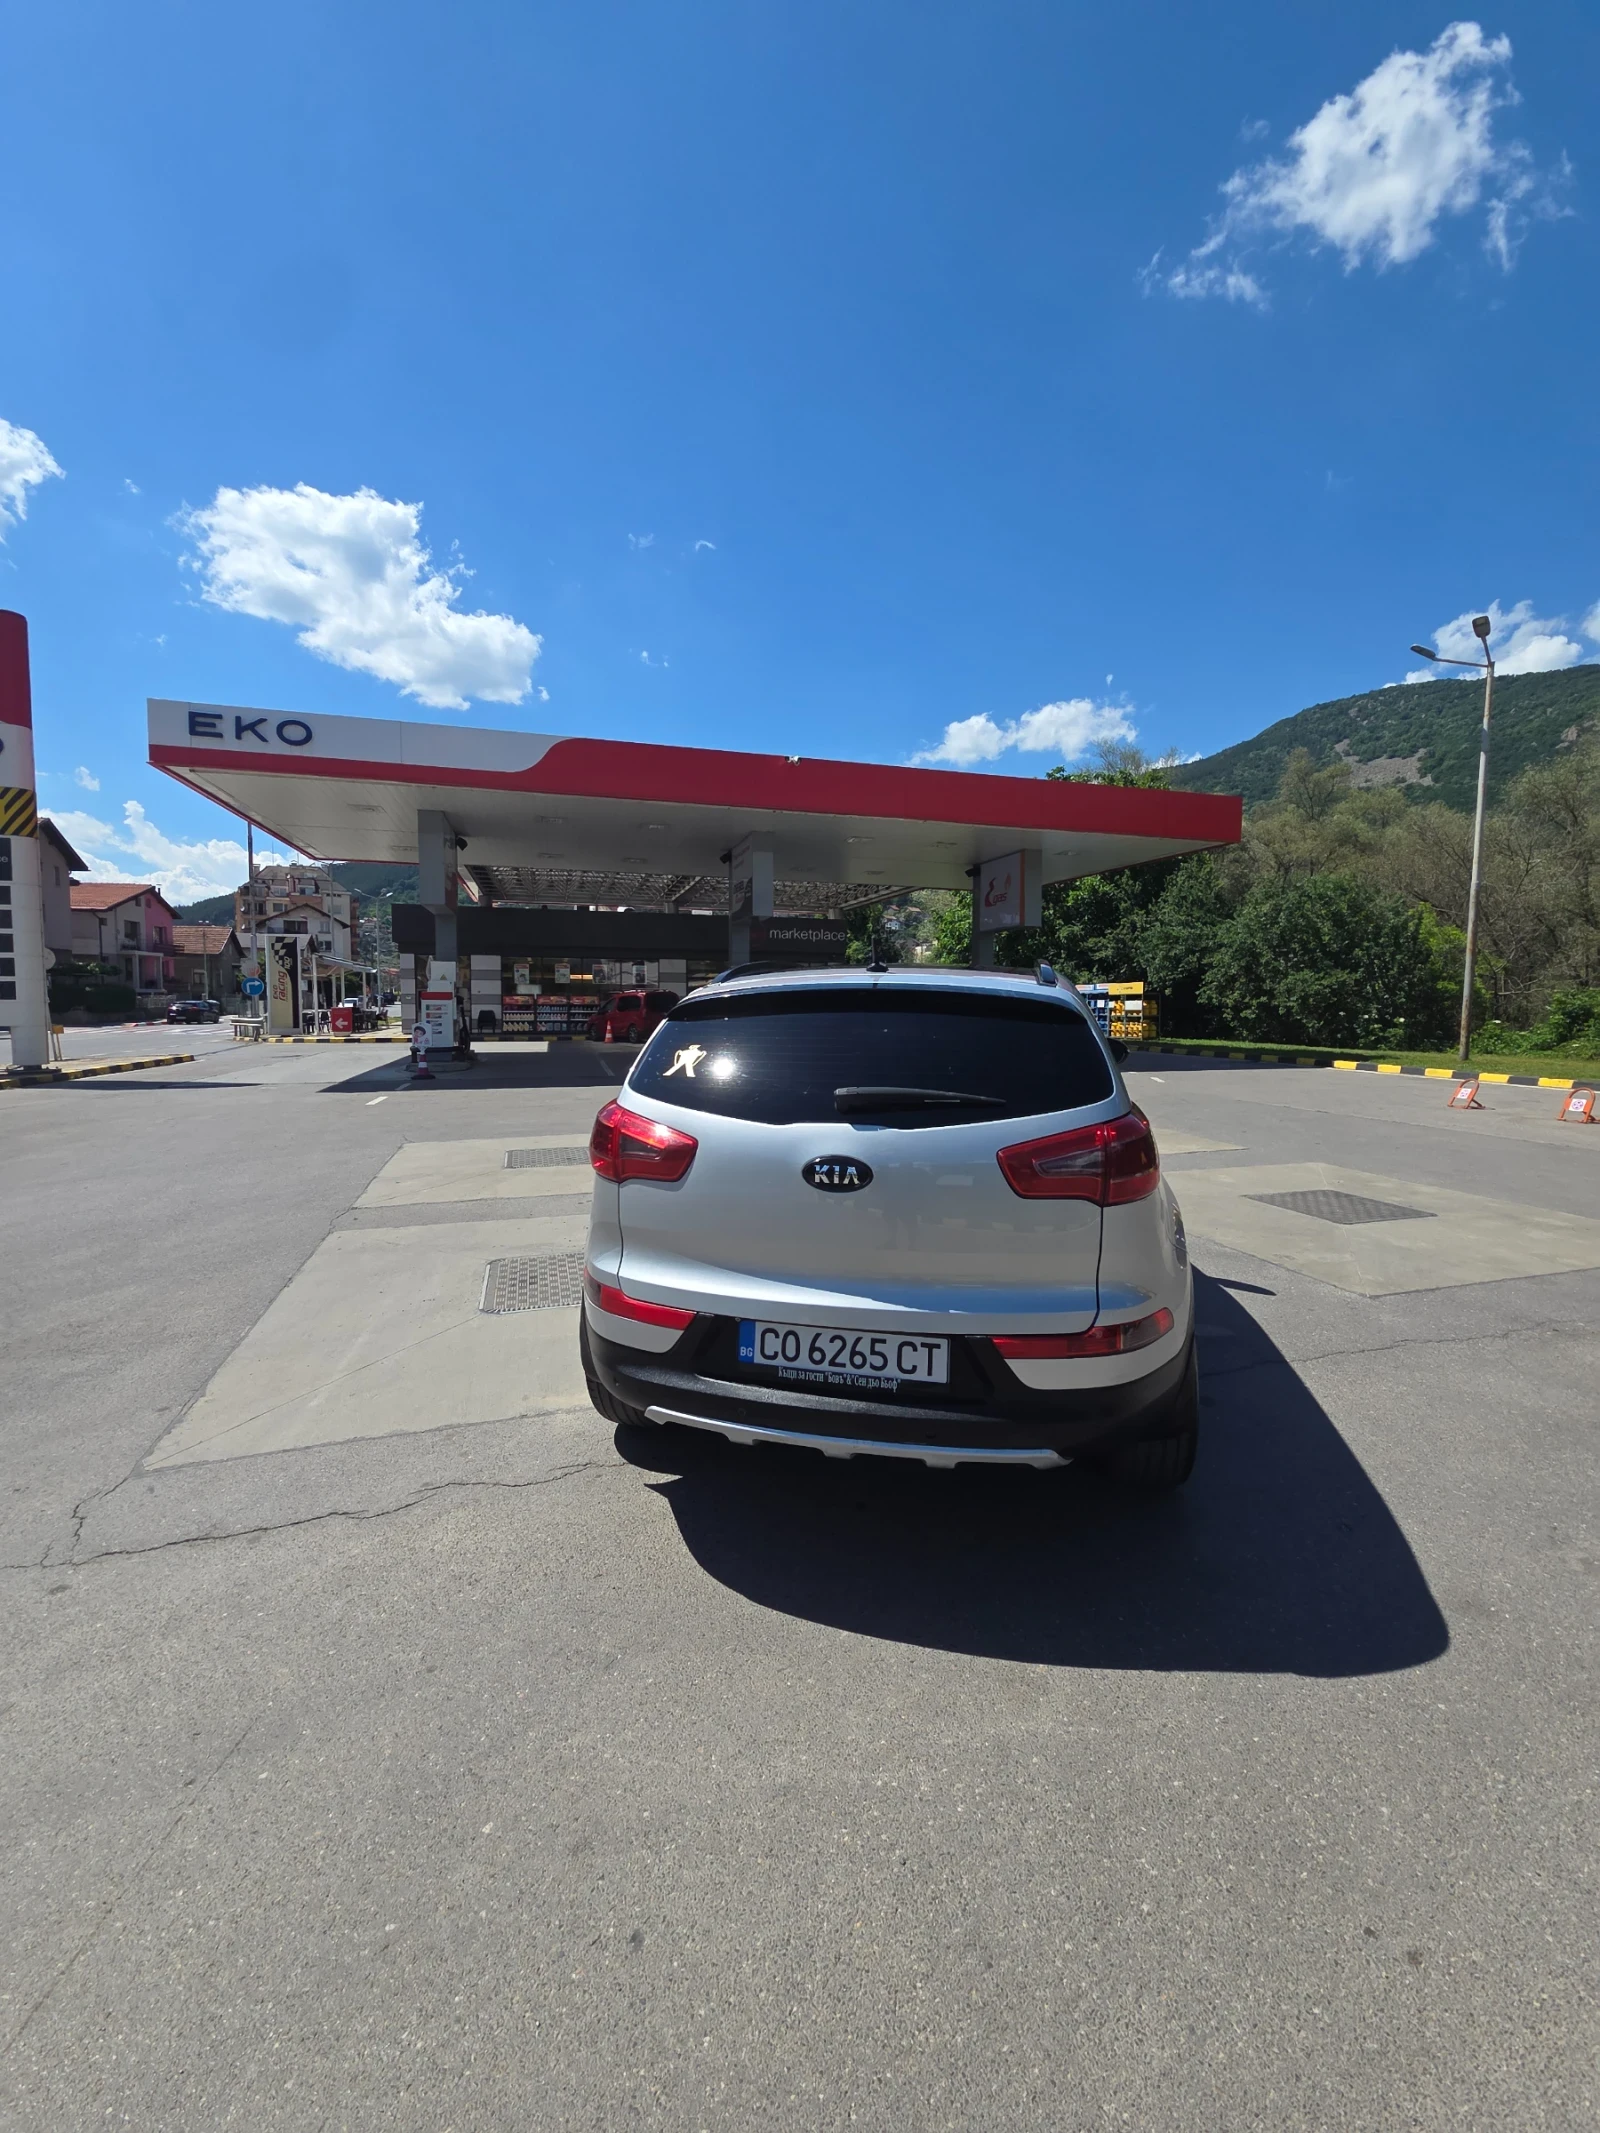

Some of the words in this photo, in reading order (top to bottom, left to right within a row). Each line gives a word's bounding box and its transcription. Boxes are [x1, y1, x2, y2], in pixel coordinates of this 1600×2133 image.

[188, 711, 313, 747] EKO
[769, 928, 846, 942] marketplace
[278, 970, 287, 1001] racing
[814, 1164, 860, 1184] KIA
[740, 1346, 753, 1357] BG
[760, 1328, 801, 1363] CO
[808, 1332, 888, 1371] 6265
[896, 1341, 941, 1376] CT
[778, 1366, 797, 1380] Къщи
[798, 1370, 805, 1379] за
[806, 1371, 824, 1382] гости
